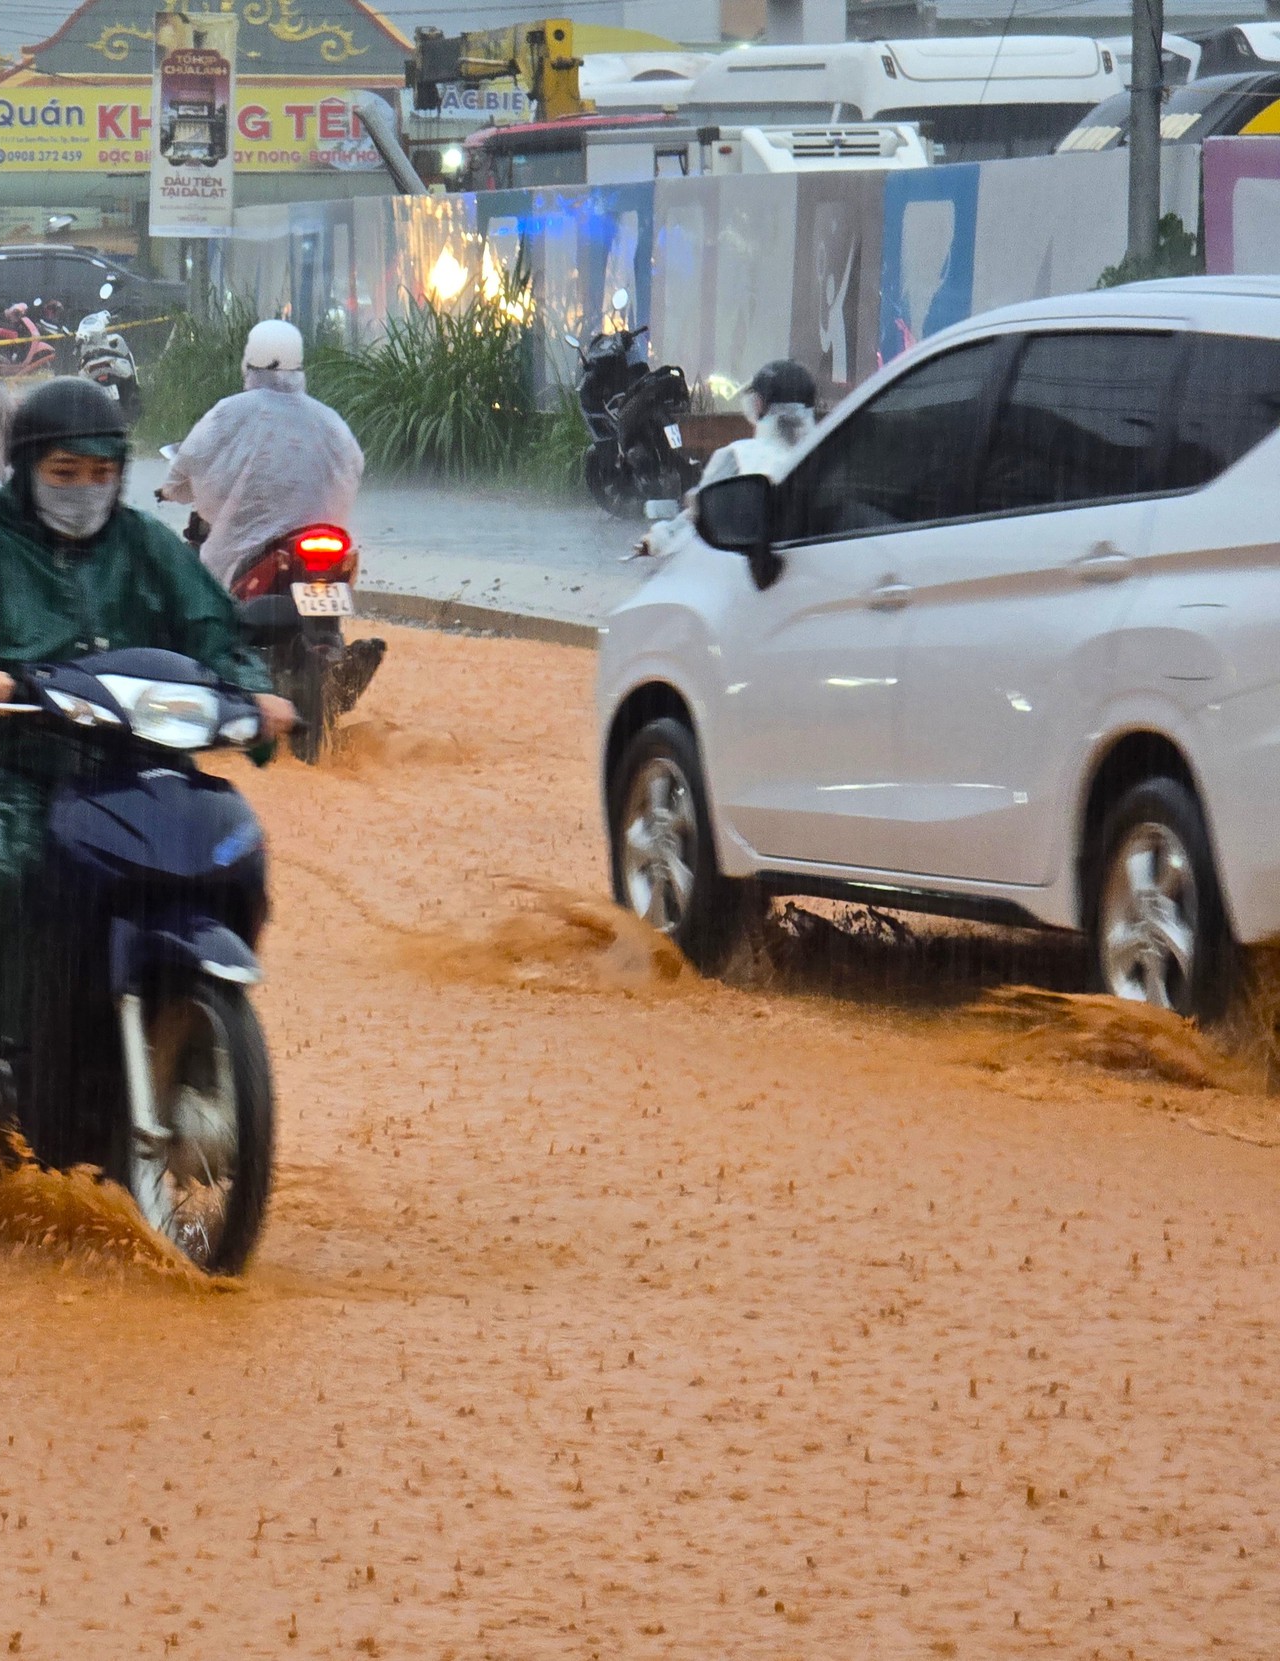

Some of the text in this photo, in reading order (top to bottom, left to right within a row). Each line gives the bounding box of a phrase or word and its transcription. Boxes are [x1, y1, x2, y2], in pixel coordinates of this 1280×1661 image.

[98, 105, 272, 139] KHG
[7, 150, 35, 162] 0908
[38, 150, 59, 162] 372
